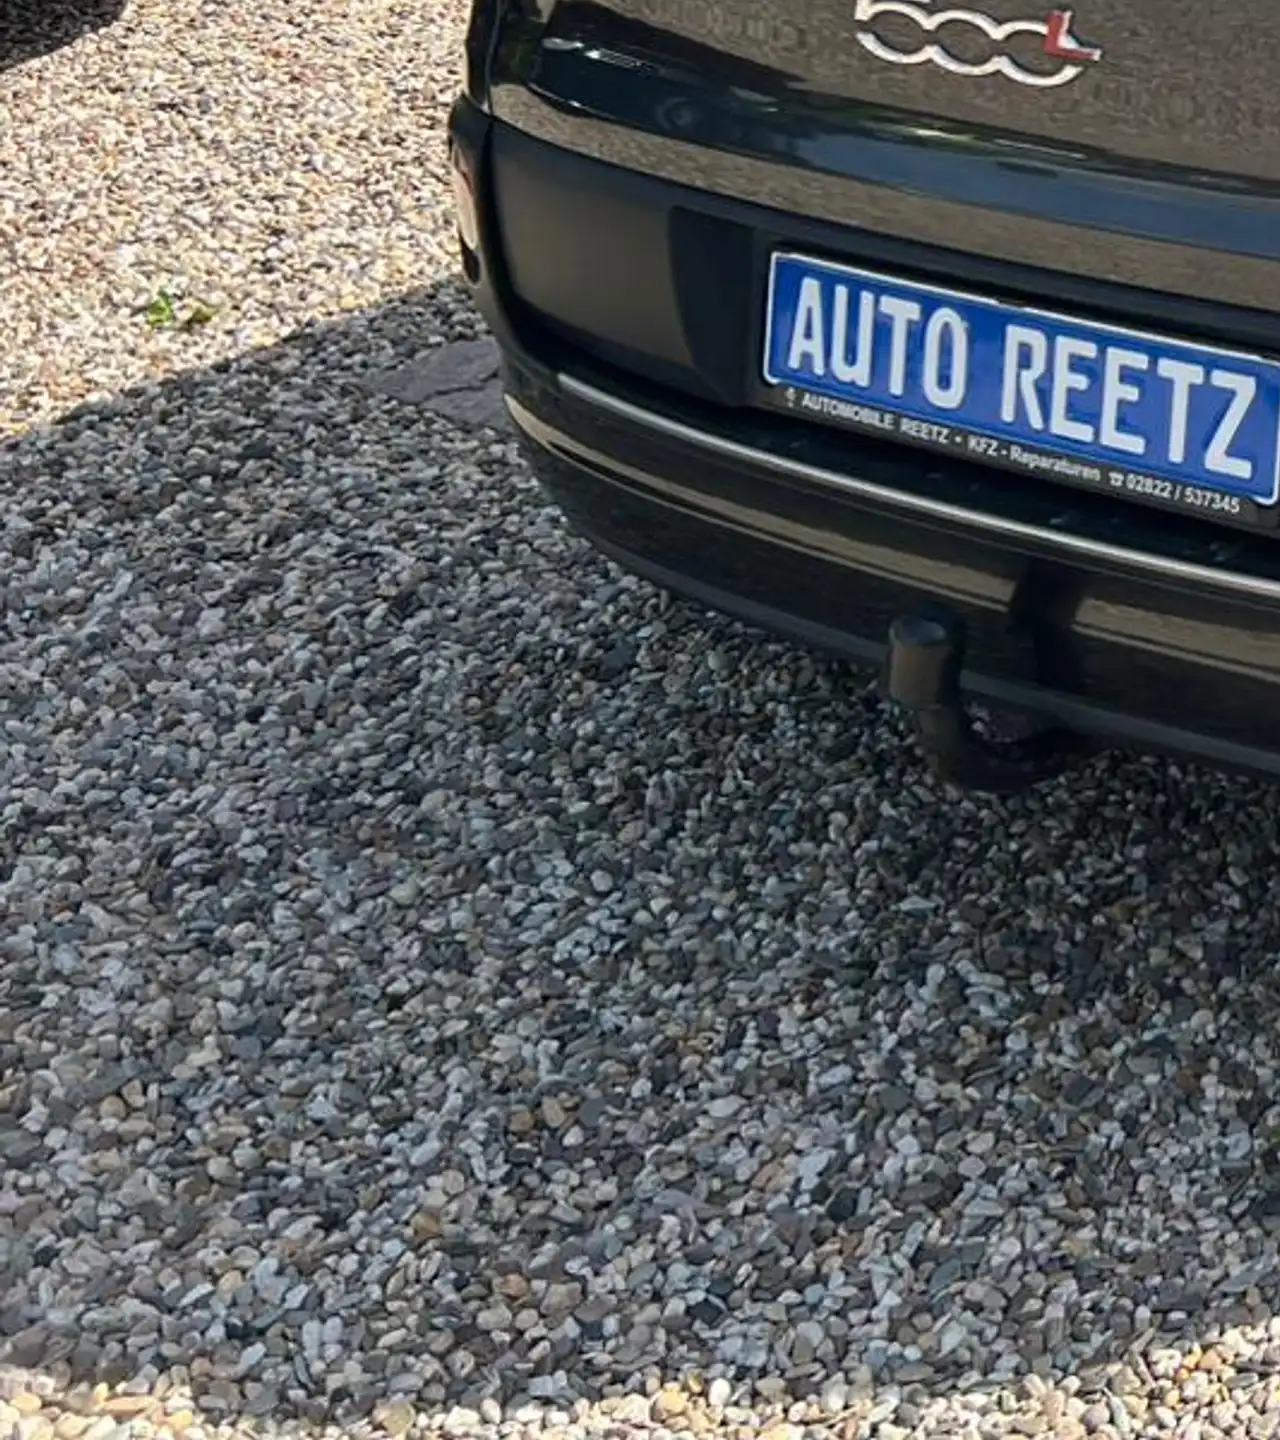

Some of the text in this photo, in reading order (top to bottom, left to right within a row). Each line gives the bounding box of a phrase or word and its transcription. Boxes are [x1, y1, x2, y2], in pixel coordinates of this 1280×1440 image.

[787, 276, 1258, 480] AUTO REETZ
[801, 392, 895, 430] AUTOMOBILE
[900, 417, 949, 444] REETZ
[1125, 474, 1174, 500] 02822
[1184, 487, 1241, 514] 537345
